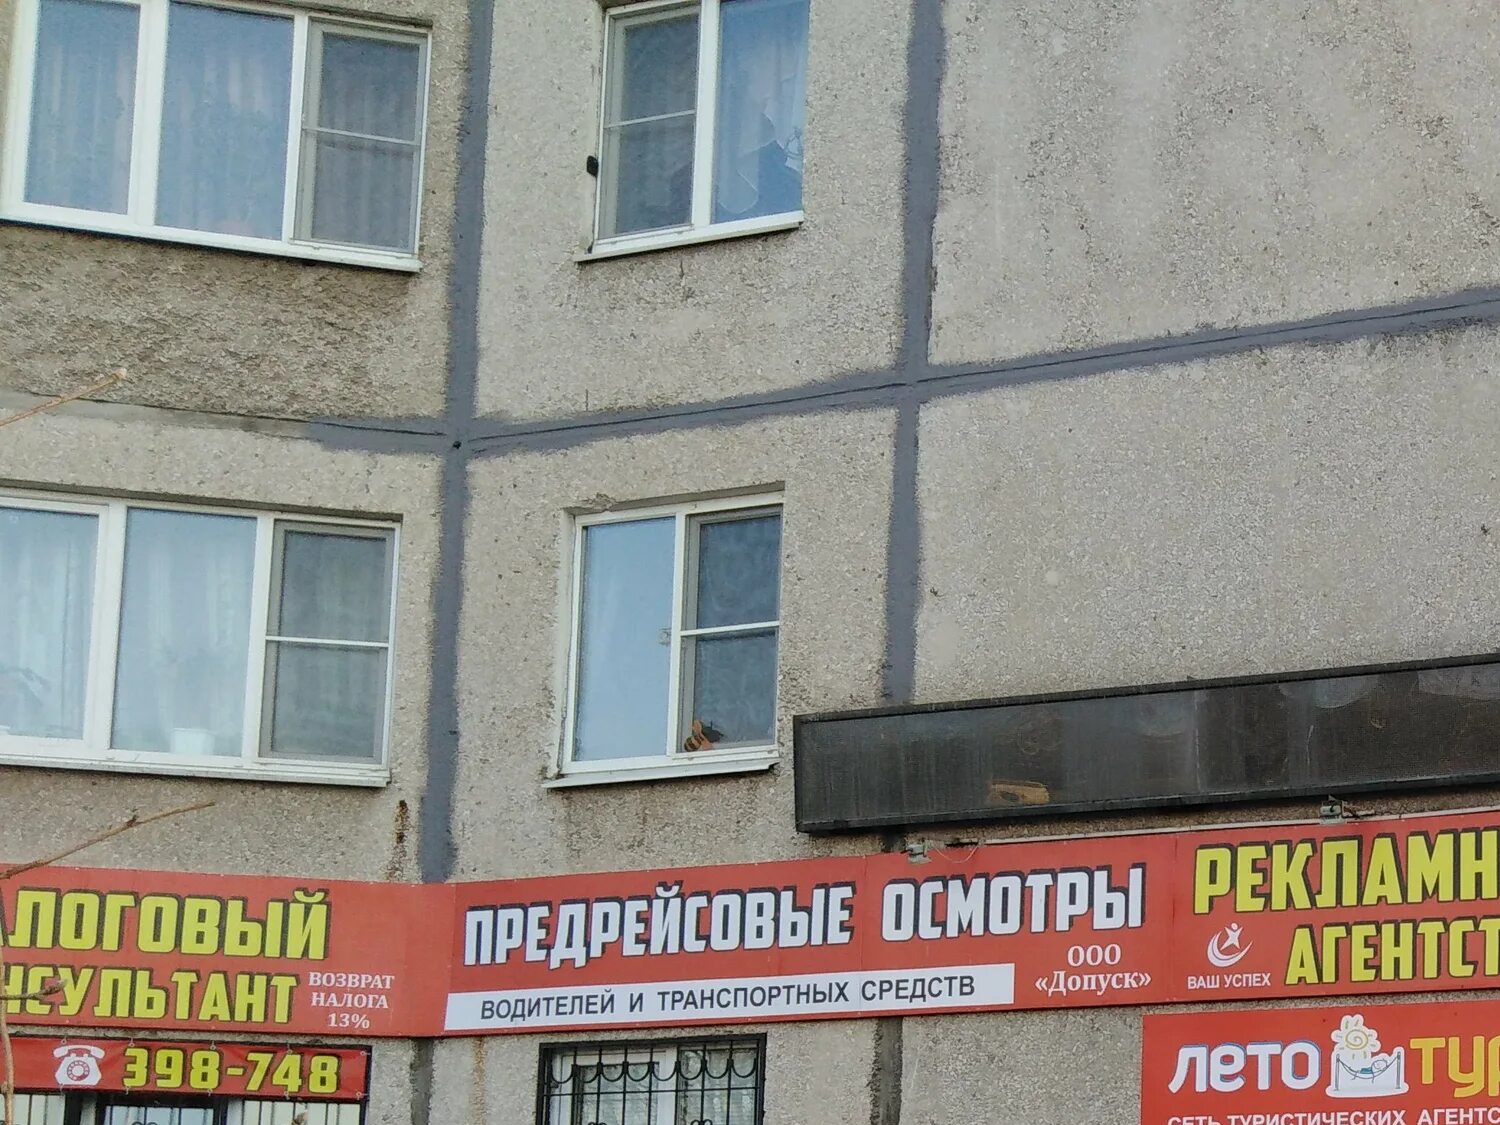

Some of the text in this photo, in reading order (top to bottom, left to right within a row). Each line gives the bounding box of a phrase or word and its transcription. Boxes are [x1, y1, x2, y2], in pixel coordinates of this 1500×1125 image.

[0, 887, 330, 960] ЛОГОВЫЙ
[463, 865, 1146, 970] ПРЕДРЕЙСОВЫЕ ОСМОТРЫ
[1067, 944, 1122, 967] ООО
[308, 971, 395, 990] ВОЗВРАТ
[1187, 972, 1271, 990] ВАШ УСПЕХ
[311, 991, 389, 1009] НАЛОГА
[480, 974, 975, 1022] ВОДИТЕЛЕЙ И ТРАНСПОРТНЫХ СРЕДСТВ
[327, 1012, 371, 1029] 13%
[123, 1046, 341, 1095] 398-748
